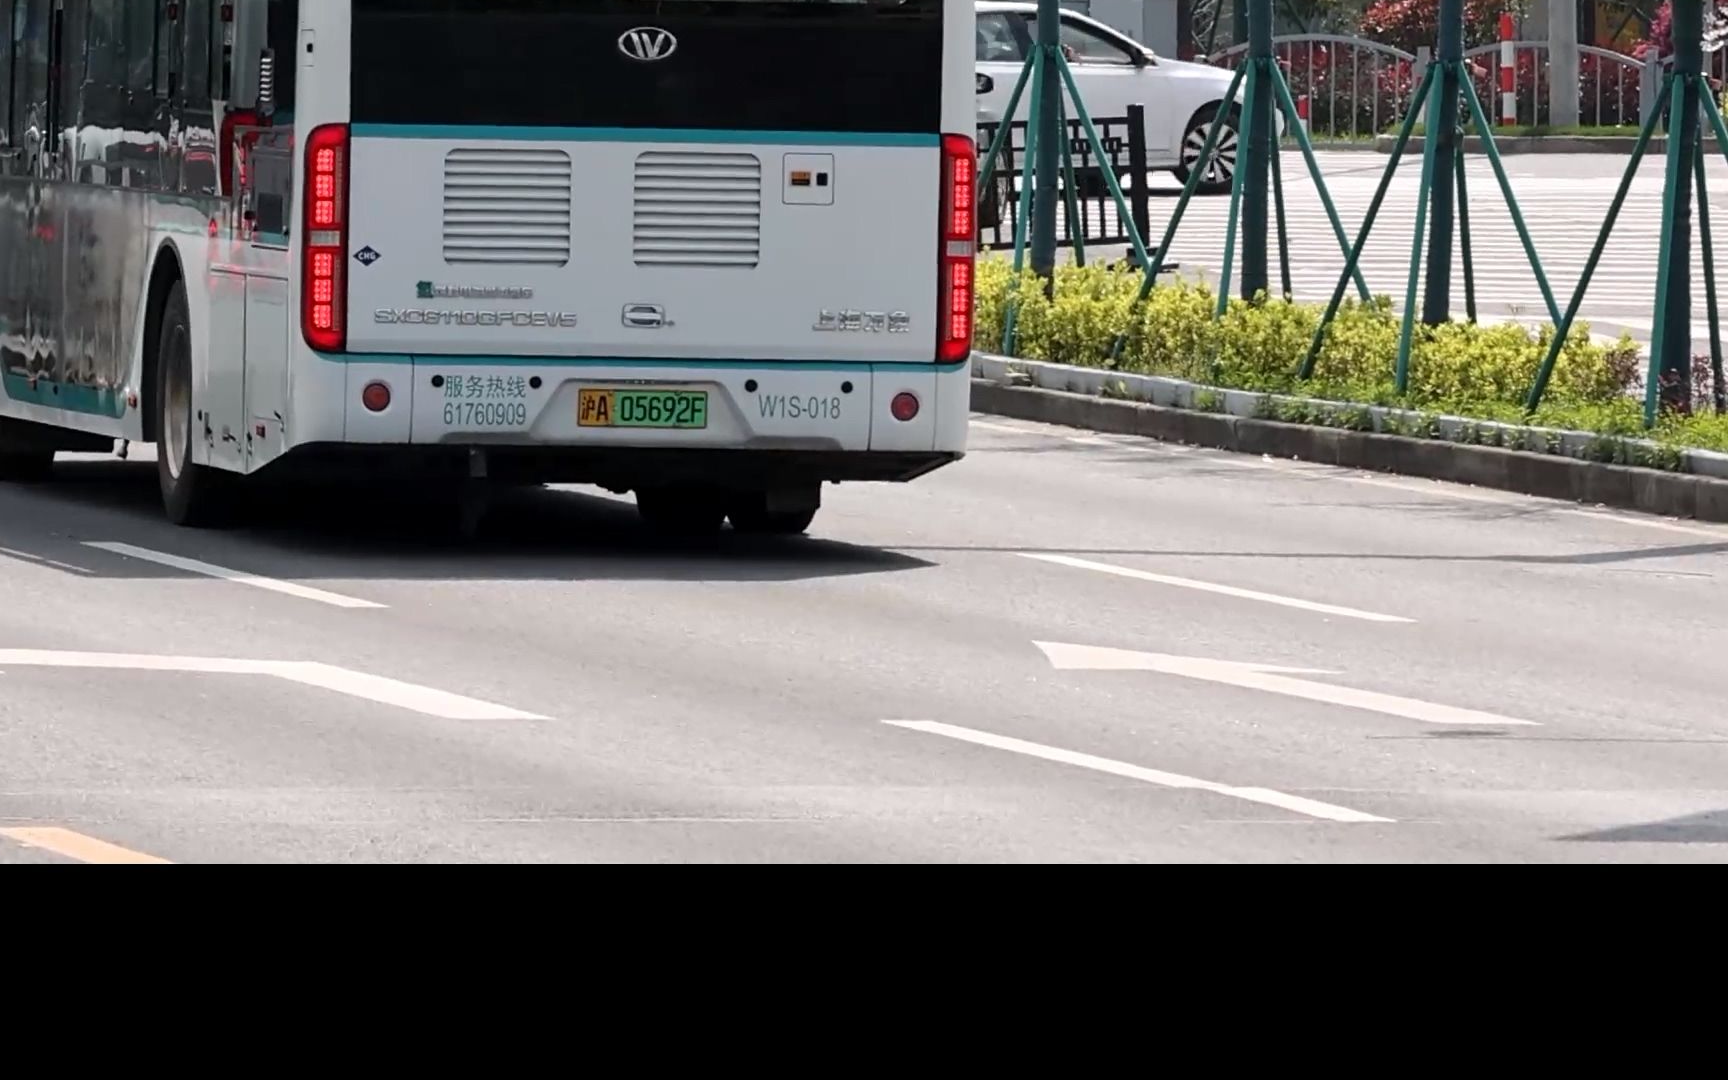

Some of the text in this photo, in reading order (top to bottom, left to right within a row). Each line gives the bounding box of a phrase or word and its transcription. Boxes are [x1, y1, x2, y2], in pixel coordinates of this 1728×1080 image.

[444, 375, 527, 399] 服务热线
[443, 402, 527, 426] 61760909
[758, 394, 841, 420] W1S-018
